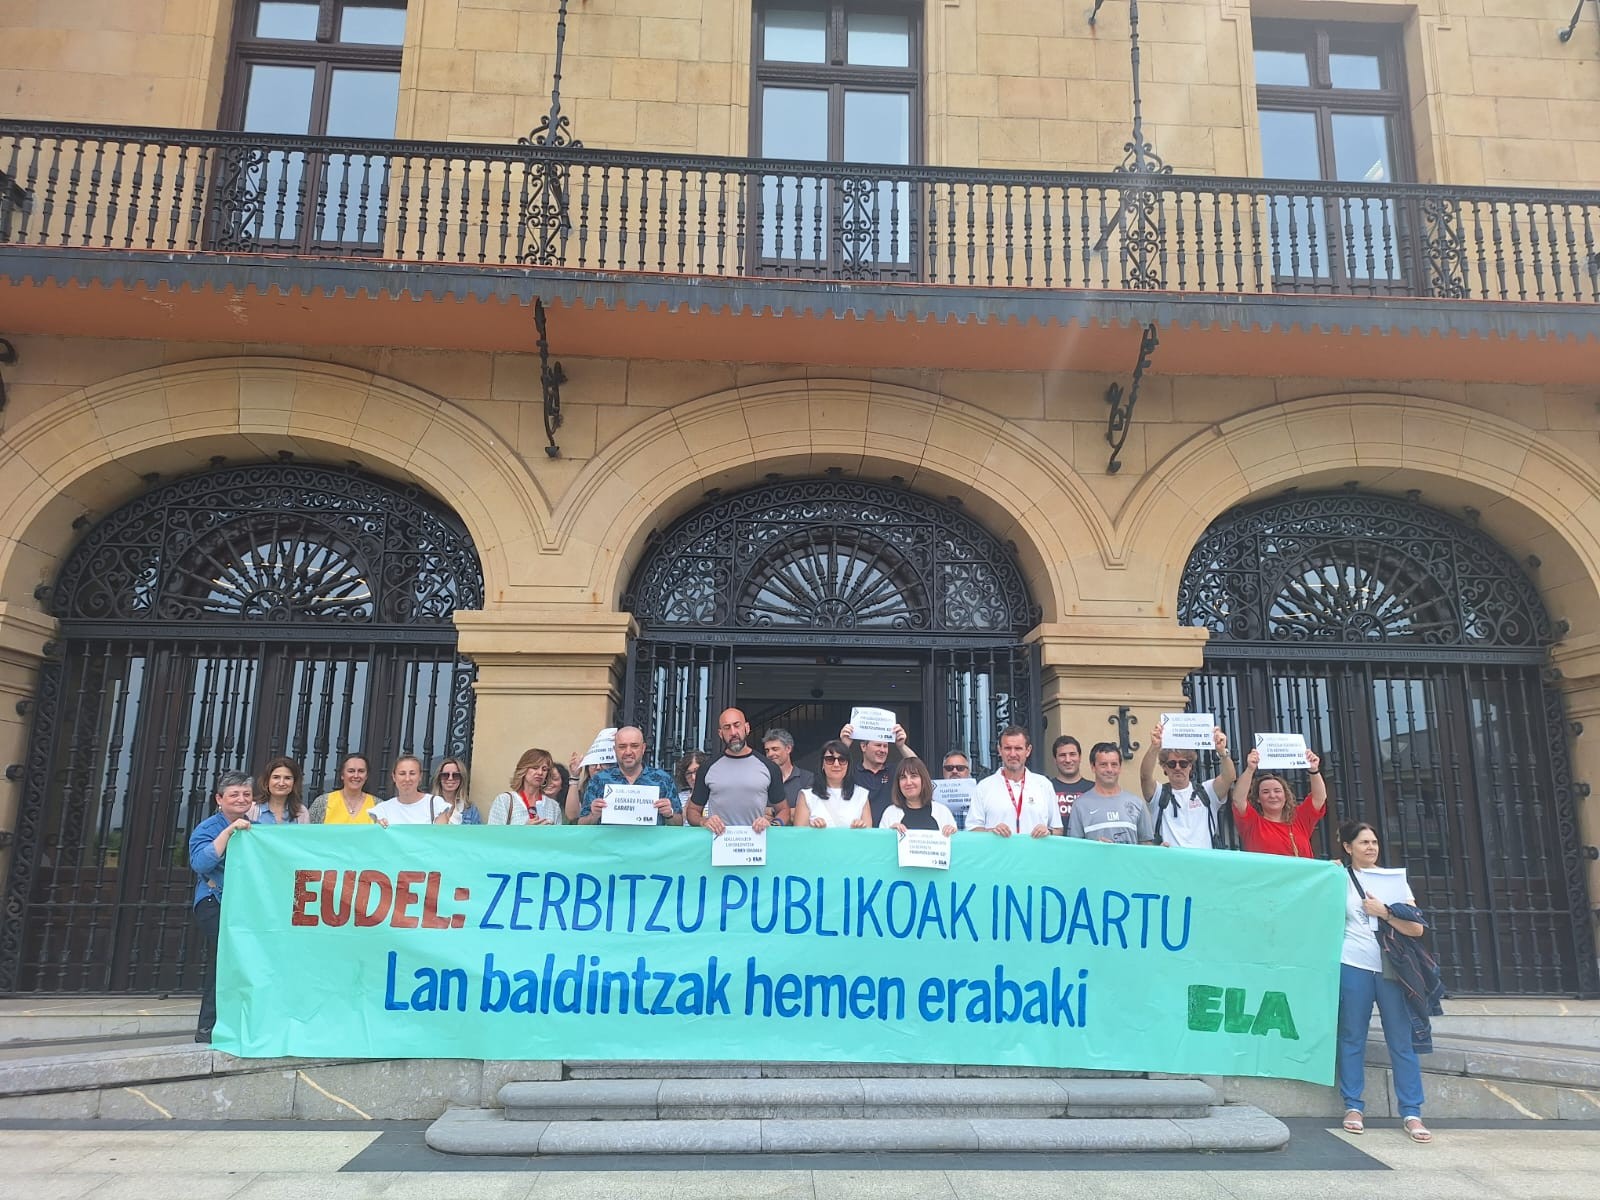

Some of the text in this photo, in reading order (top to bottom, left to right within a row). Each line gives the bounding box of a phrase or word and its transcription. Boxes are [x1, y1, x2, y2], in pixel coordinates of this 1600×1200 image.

[291, 869, 1193, 952] EUDEL: ZERBITZU PUBLIKOAK INDARTU
[384, 951, 1089, 1028] Lan baldintzak hemen erabaki
[1187, 984, 1300, 1041] ELA
